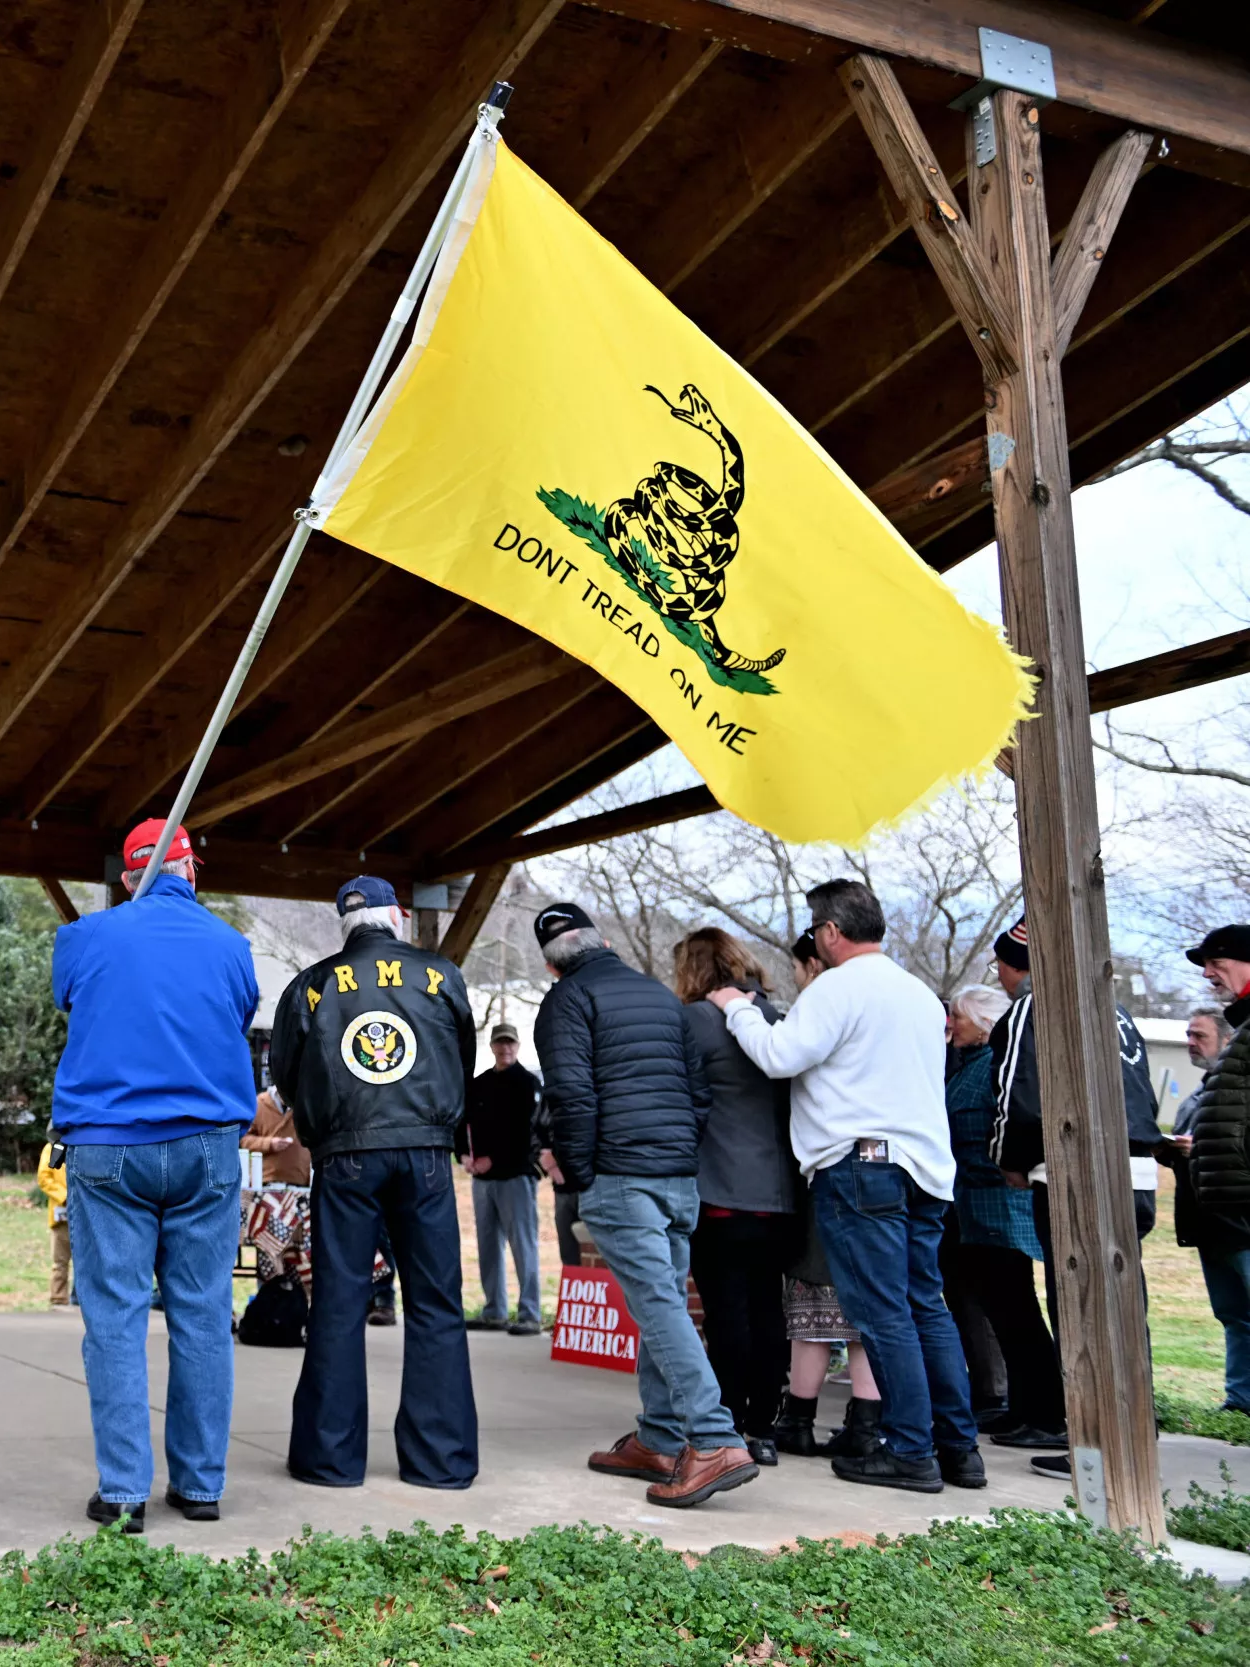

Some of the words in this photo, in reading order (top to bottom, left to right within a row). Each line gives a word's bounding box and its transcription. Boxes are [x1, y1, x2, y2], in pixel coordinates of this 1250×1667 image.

[493, 523, 578, 584] DONT
[582, 578, 660, 658] TREAD
[670, 668, 702, 711] ON
[706, 710, 757, 755] ME
[306, 960, 444, 1012] ARMY
[560, 1278, 608, 1305] LOOK
[557, 1302, 619, 1331] AHEAD
[554, 1326, 635, 1360] AMERICA
